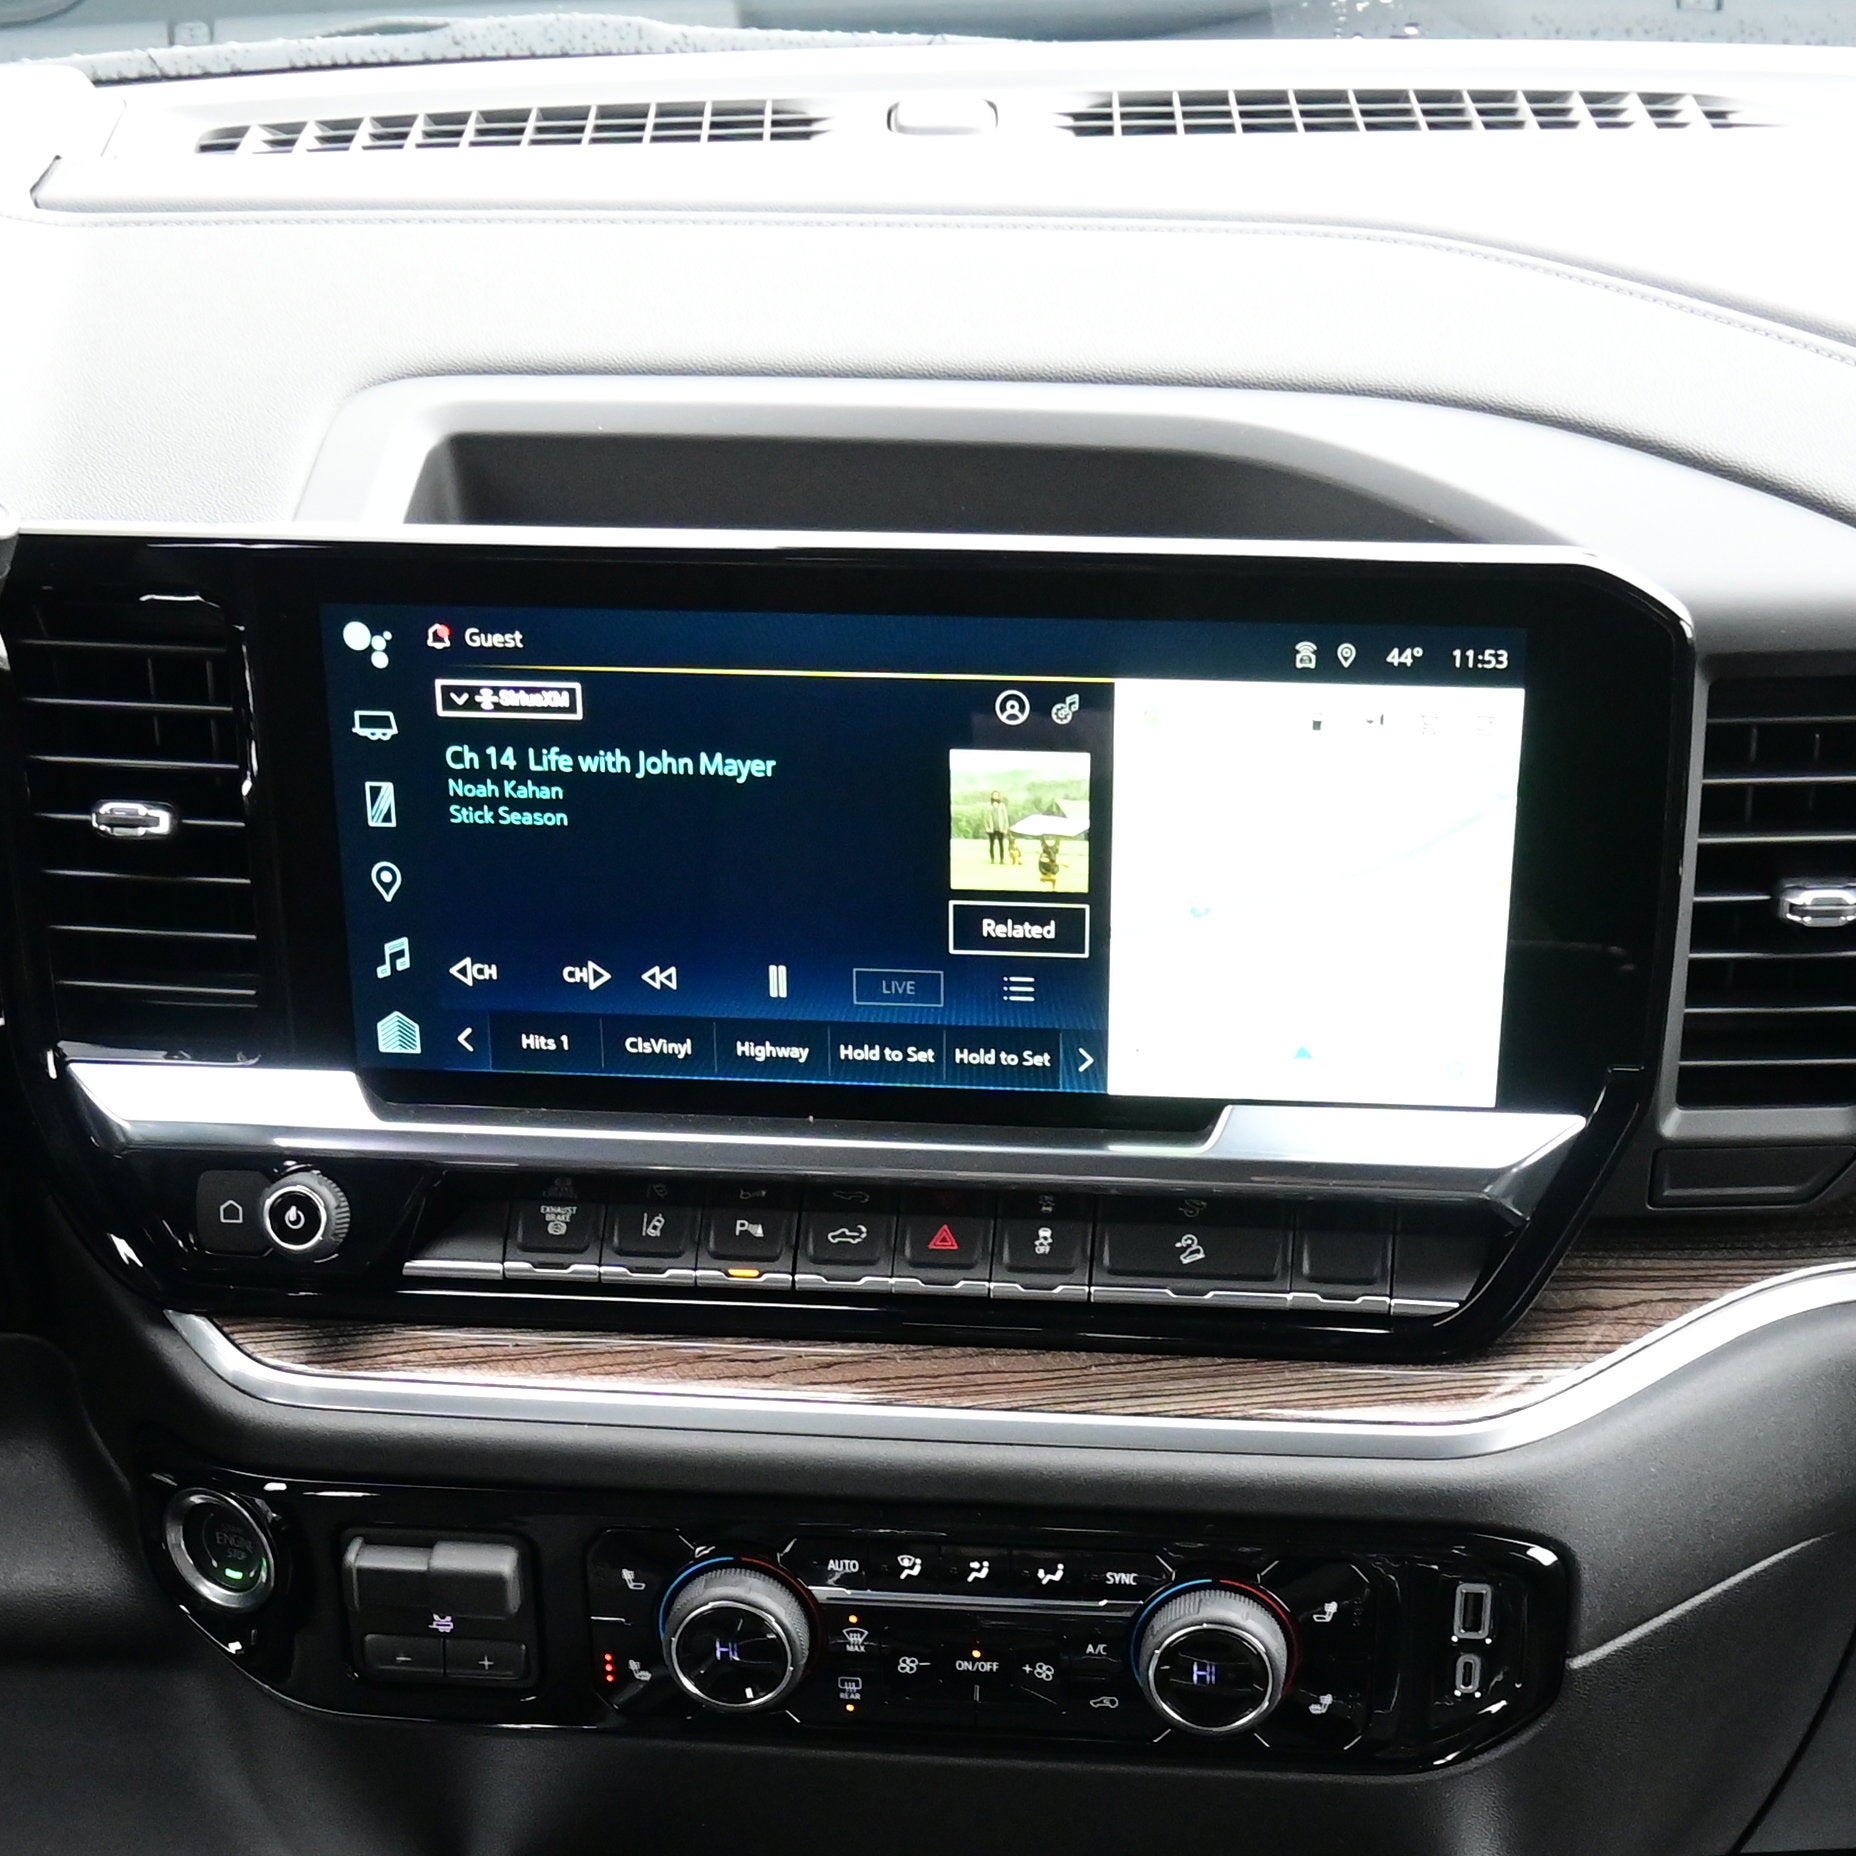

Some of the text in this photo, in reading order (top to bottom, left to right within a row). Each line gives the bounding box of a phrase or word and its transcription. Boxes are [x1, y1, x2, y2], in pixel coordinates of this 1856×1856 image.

[464, 627, 524, 649] Guest
[1452, 649, 1509, 669] 11:53
[446, 745, 777, 784] Ch 14 Life with John Mayer
[448, 779, 564, 800] Noah Kahan
[449, 805, 568, 826] Stick Season
[982, 918, 1056, 940] Related
[472, 963, 498, 980] CH
[562, 966, 588, 983] CH
[882, 979, 916, 995] LIVE
[521, 1033, 569, 1051] Hits 1
[624, 1036, 693, 1059] ClsVinyl
[736, 1041, 809, 1063] Highway
[839, 1044, 935, 1063] Hold to Set
[954, 1048, 1051, 1067] Hold to Set
[540, 1205, 578, 1215] EXHAUST
[545, 1213, 571, 1222] BRAKE
[827, 1559, 859, 1573] AUTO
[1105, 1572, 1137, 1585] SYNC
[845, 1644, 866, 1653] MAX
[1086, 1643, 1108, 1656] A/C
[955, 1660, 999, 1673] ON/OFF
[839, 1691, 861, 1700] REAR
